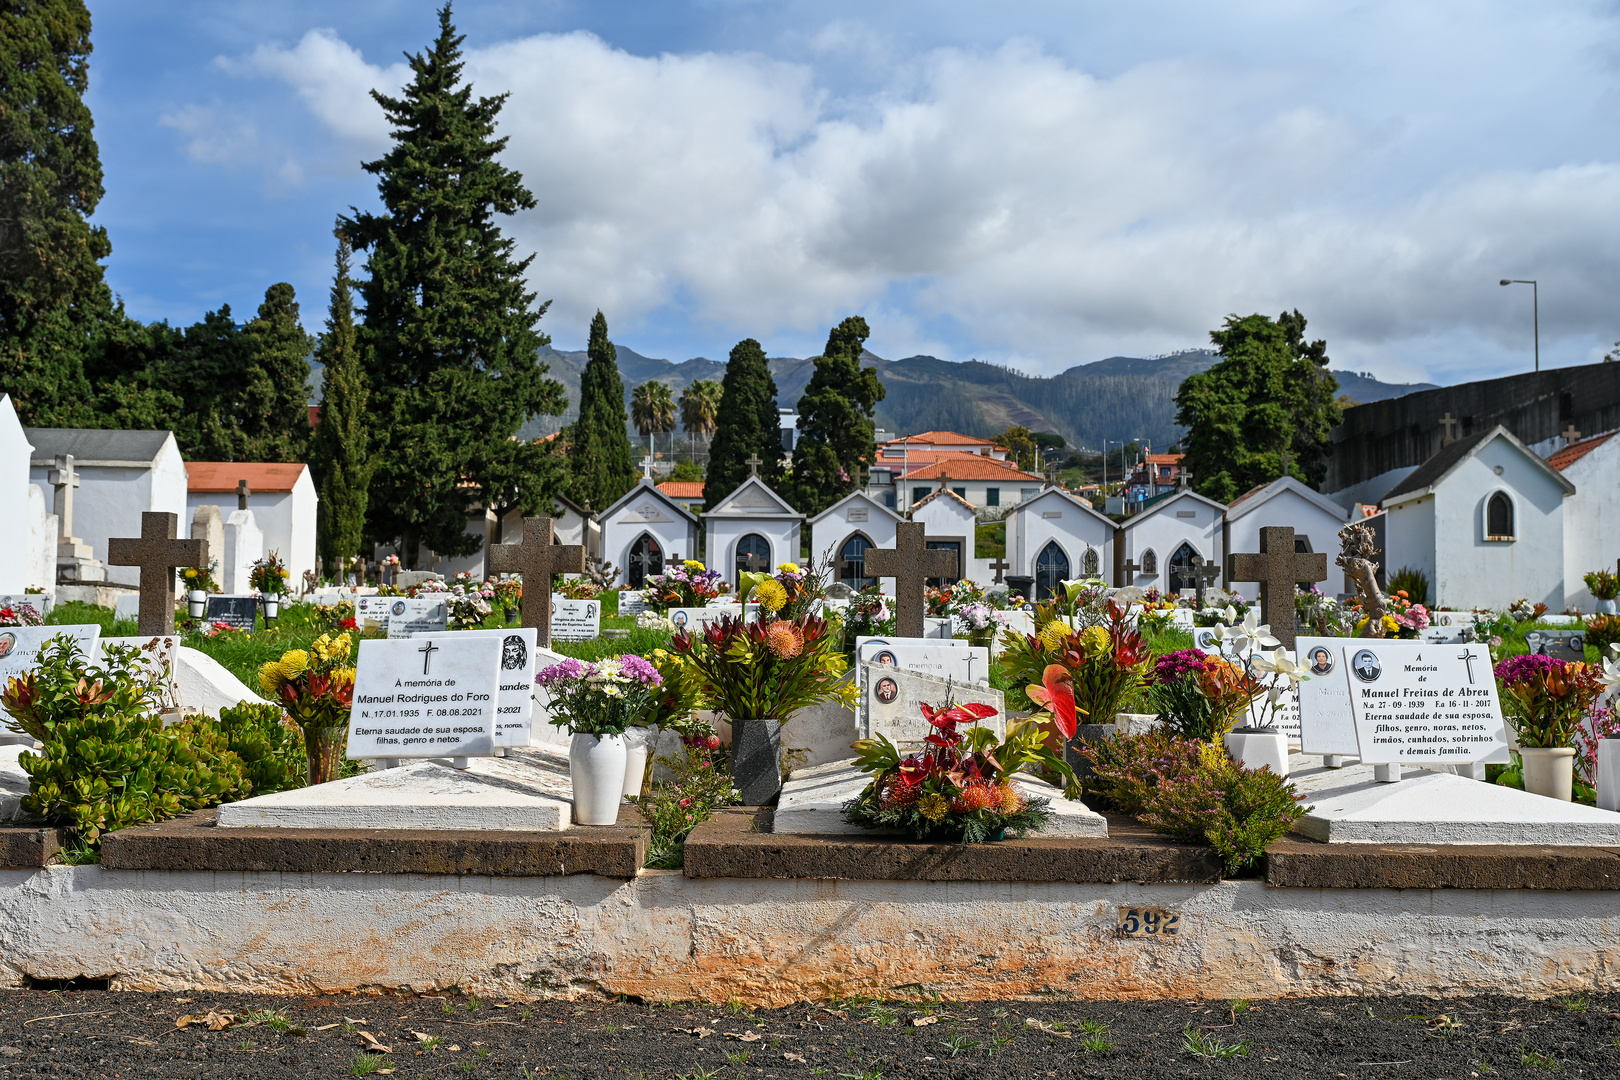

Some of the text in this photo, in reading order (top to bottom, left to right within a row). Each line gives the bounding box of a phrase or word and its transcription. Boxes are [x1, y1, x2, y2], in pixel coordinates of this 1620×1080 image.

[1416, 653, 1422, 661] À
[395, 678, 402, 687] À
[404, 679, 442, 687] memória
[1361, 687, 1489, 698] Manuel Freitas de Abreu
[357, 692, 490, 704] Manuel Rodrigues do Foro
[374, 709, 420, 718] 17.01.1935
[436, 708, 482, 716] 08.08.2021
[1365, 712, 1392, 720] Eterna
[1395, 712, 1430, 720] saudade
[385, 727, 420, 735] saudade
[1374, 724, 1402, 734] filhos,
[403, 737, 427, 745] genro
[1373, 734, 1494, 744] irmãos, cunhados, sobrinhos
[1407, 747, 1436, 755] demais
[1438, 746, 1471, 756] família.
[1123, 909, 1179, 934] 592
